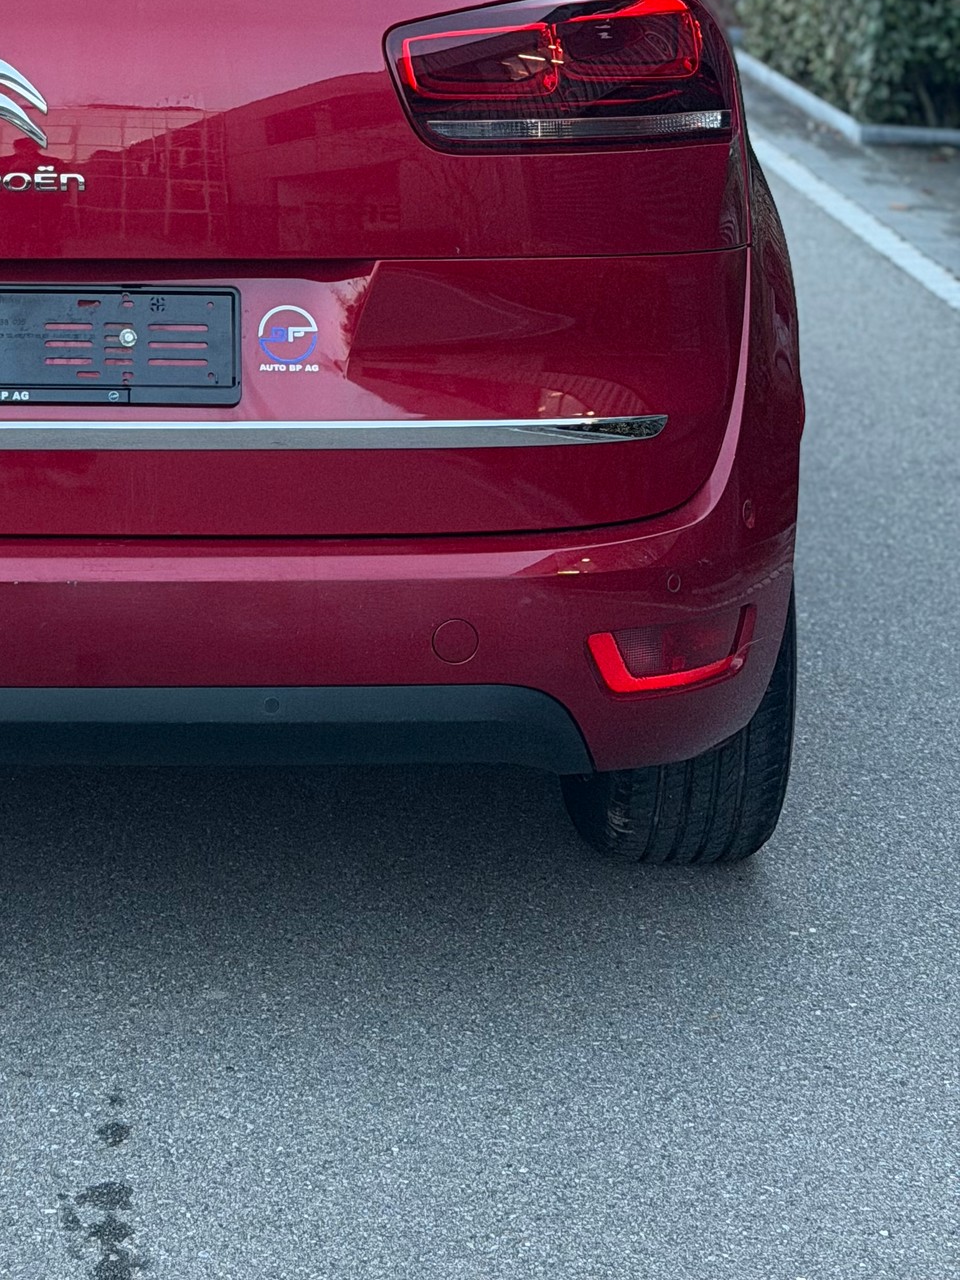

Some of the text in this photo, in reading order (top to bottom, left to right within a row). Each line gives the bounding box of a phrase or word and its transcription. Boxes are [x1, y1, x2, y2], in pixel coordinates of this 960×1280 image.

[259, 364, 320, 372] AUTO BP AG
[12, 391, 30, 400] AG
